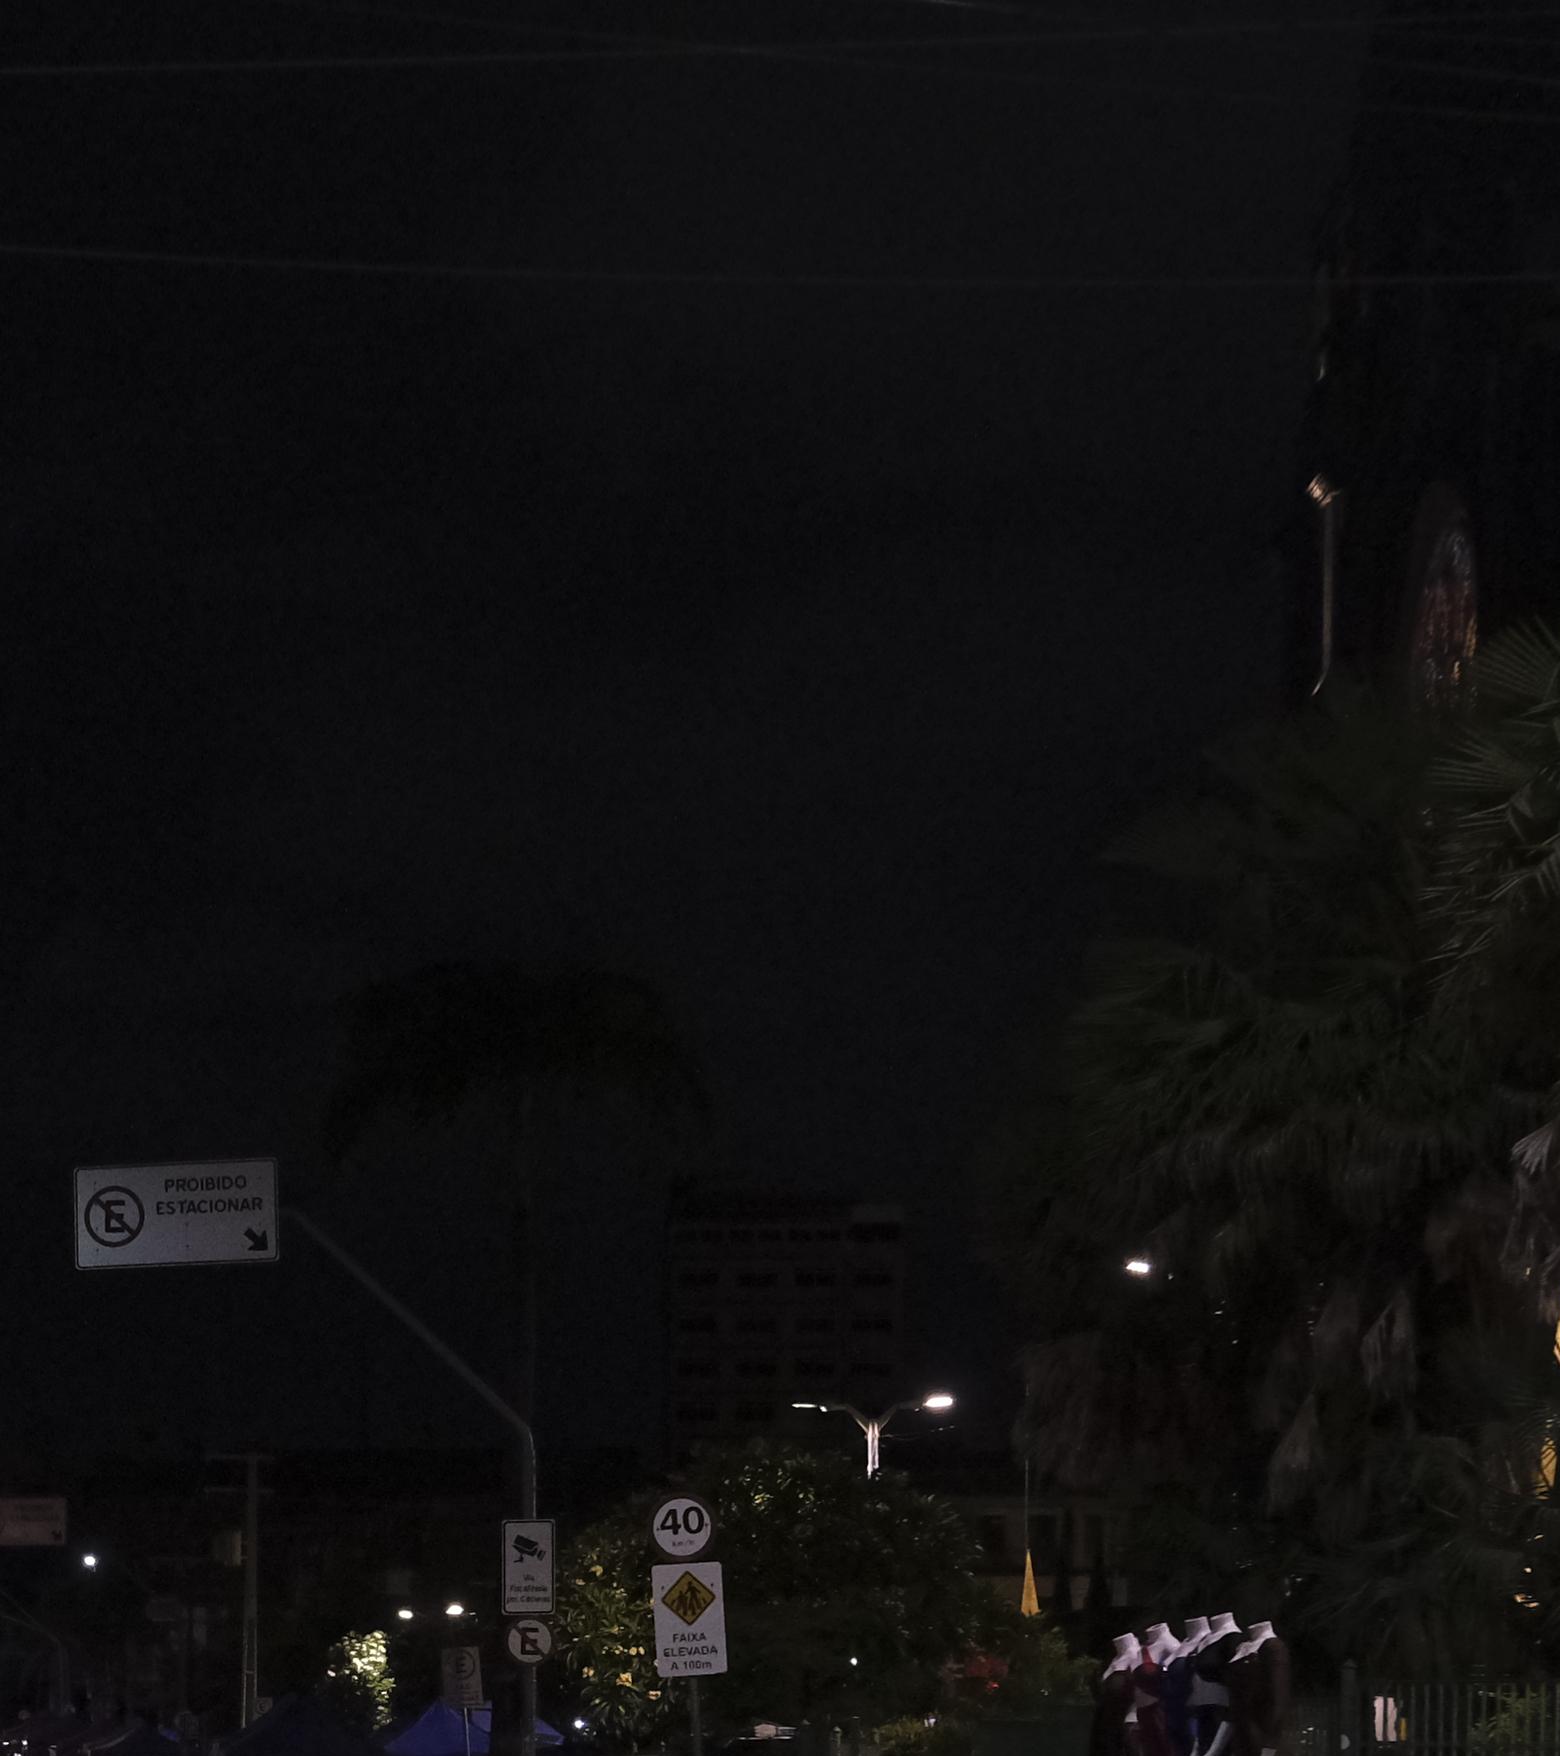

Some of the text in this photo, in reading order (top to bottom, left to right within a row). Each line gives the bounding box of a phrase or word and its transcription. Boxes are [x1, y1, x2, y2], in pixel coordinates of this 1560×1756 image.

[164, 1175, 247, 1193] PROIBIDO
[156, 1197, 264, 1215] ESTACIONAR
[660, 1506, 706, 1536] 40
[672, 1632, 707, 1643] FAIXA
[663, 1645, 718, 1658] ELEVADA
[671, 1660, 713, 1670] A 100m
